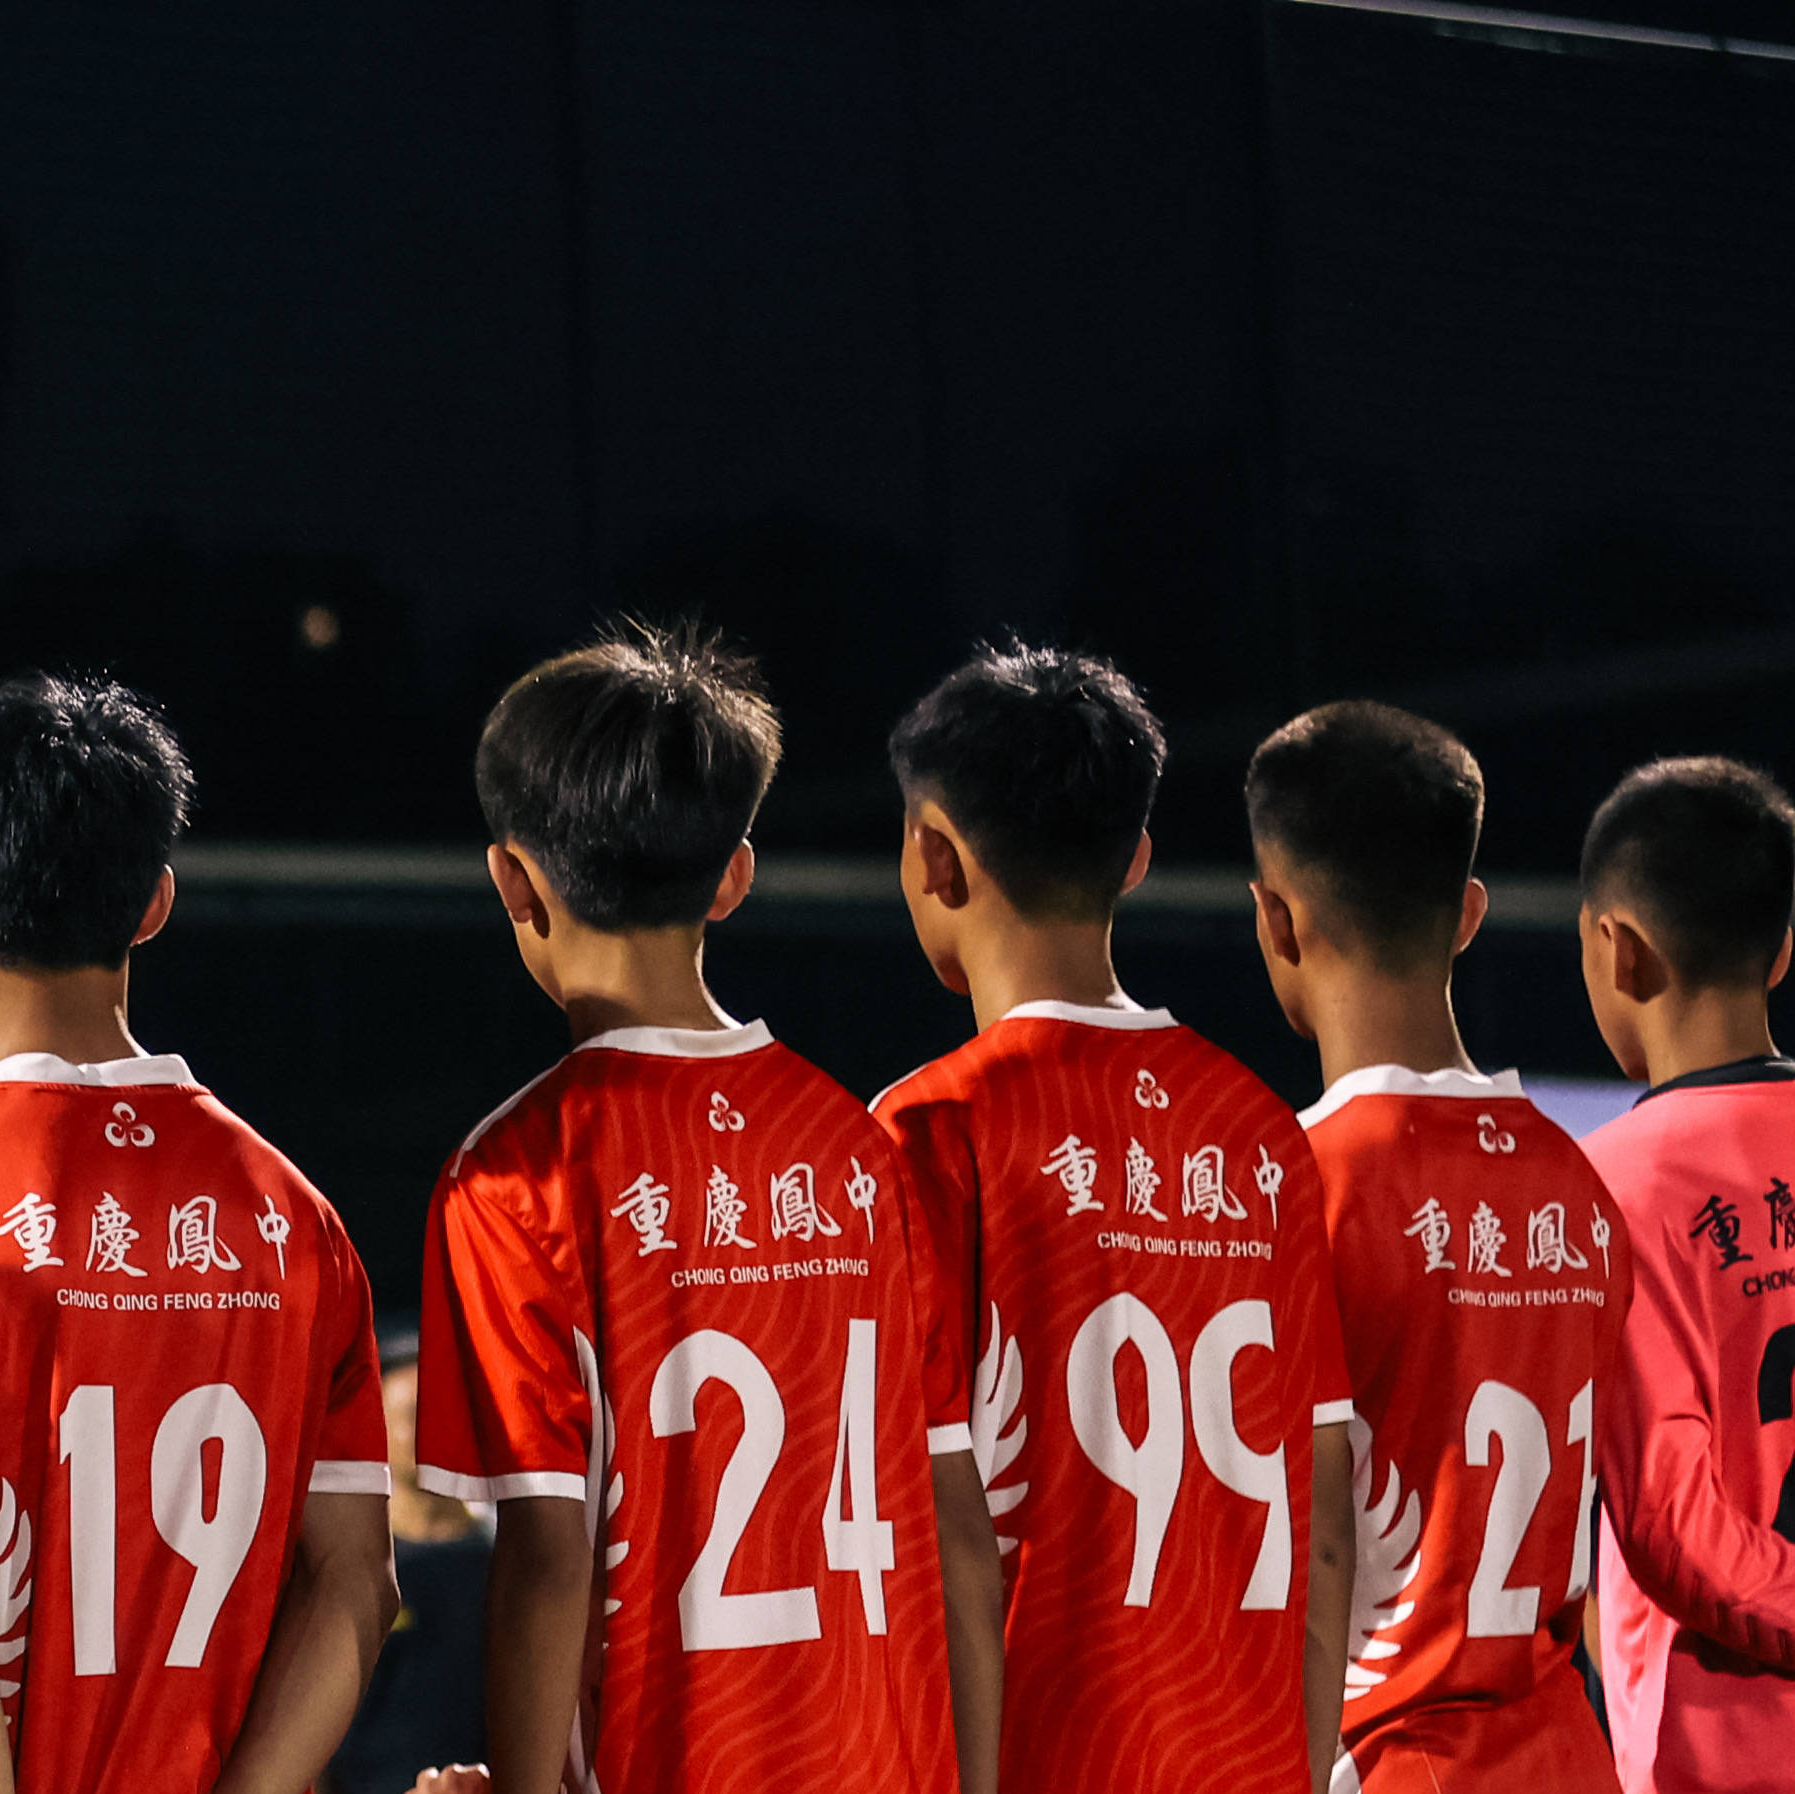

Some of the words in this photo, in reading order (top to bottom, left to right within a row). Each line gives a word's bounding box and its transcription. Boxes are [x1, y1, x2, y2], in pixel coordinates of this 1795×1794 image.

[611, 1157, 877, 1256] 重慶鳳中
[1041, 1135, 1284, 1229] 重慶鳳中
[671, 1267, 726, 1288] CHONG
[729, 1266, 770, 1284] QING
[772, 1258, 823, 1281] FENG
[1144, 1236, 1177, 1256] QING
[1180, 1239, 1222, 1257] FENG
[1404, 1198, 1610, 1279] 重慶鳳中
[56, 1288, 109, 1309] CHONG
[113, 1293, 158, 1311] QING
[163, 1292, 213, 1310] FENG
[216, 1291, 280, 1310] ZHONG
[650, 1318, 895, 1651] 24
[60, 1384, 266, 1675] 19
